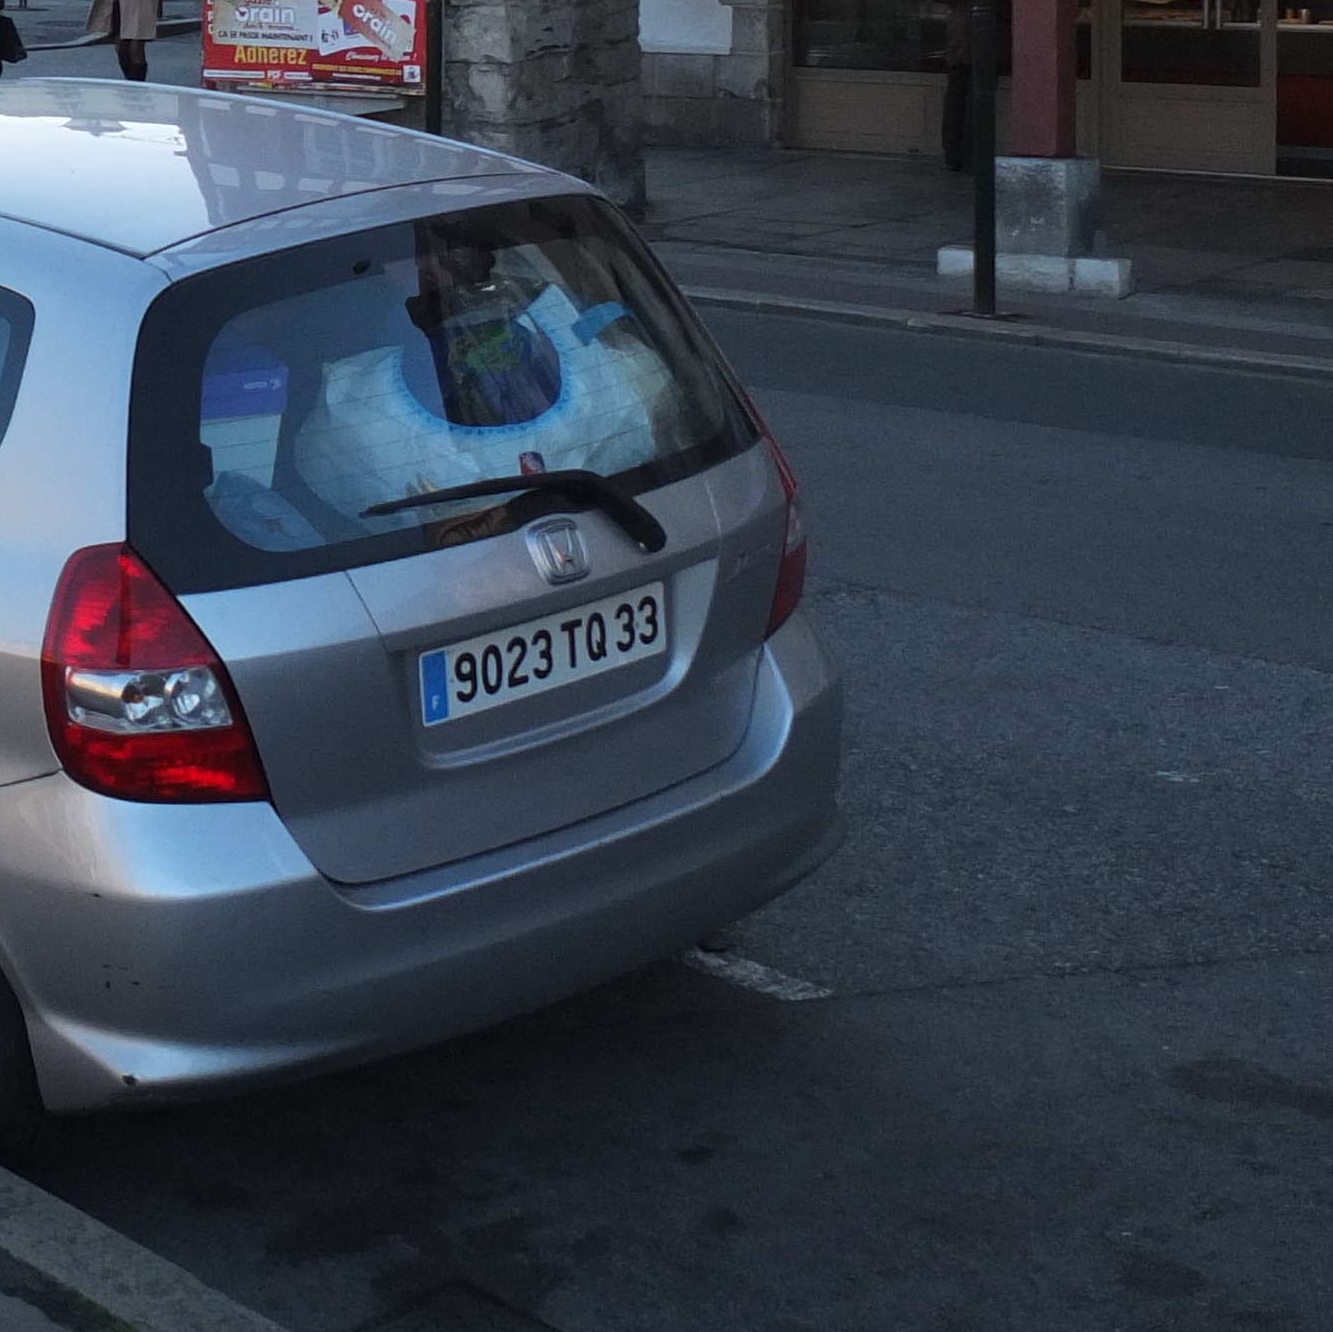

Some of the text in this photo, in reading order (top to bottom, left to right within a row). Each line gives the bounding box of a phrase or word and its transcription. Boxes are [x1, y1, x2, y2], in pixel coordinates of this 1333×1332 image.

[454, 595, 659, 703] 9023 TQ 33
